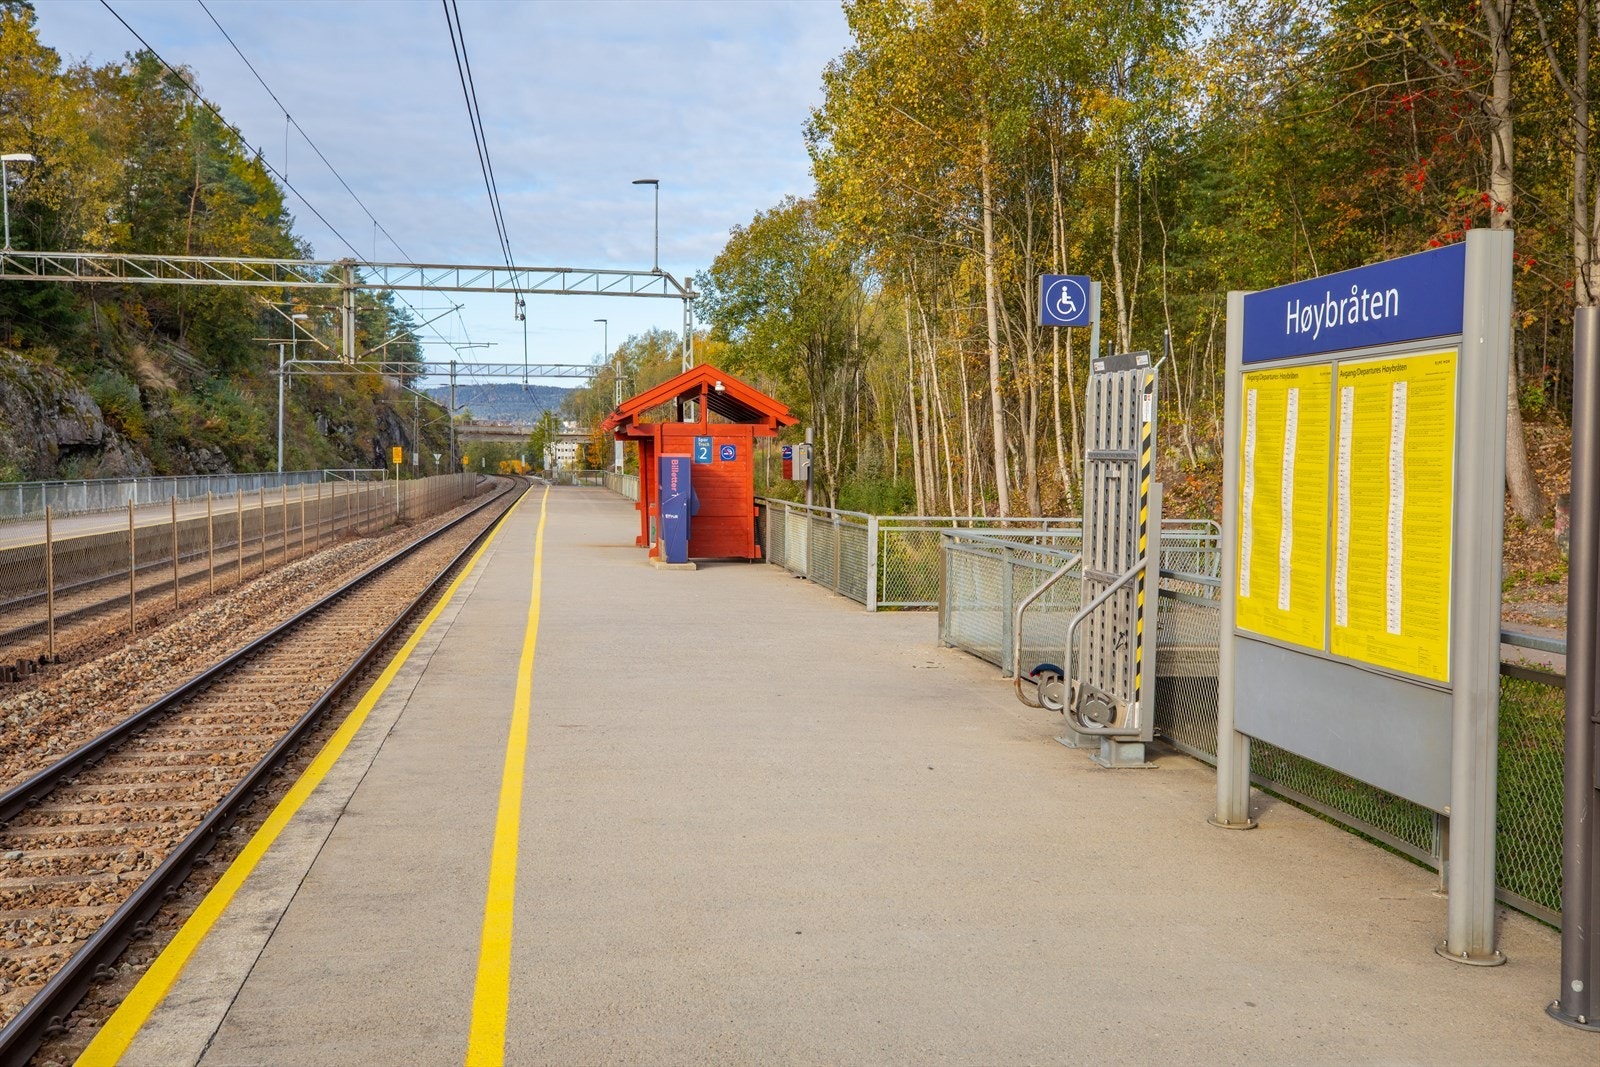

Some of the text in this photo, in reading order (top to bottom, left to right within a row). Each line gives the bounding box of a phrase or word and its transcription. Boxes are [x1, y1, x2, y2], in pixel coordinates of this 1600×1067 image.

[1286, 284, 1399, 341] Høybråten
[1382, 363, 1408, 375] Høybråten
[699, 447, 708, 460] 2
[671, 459, 679, 492] Billetter
